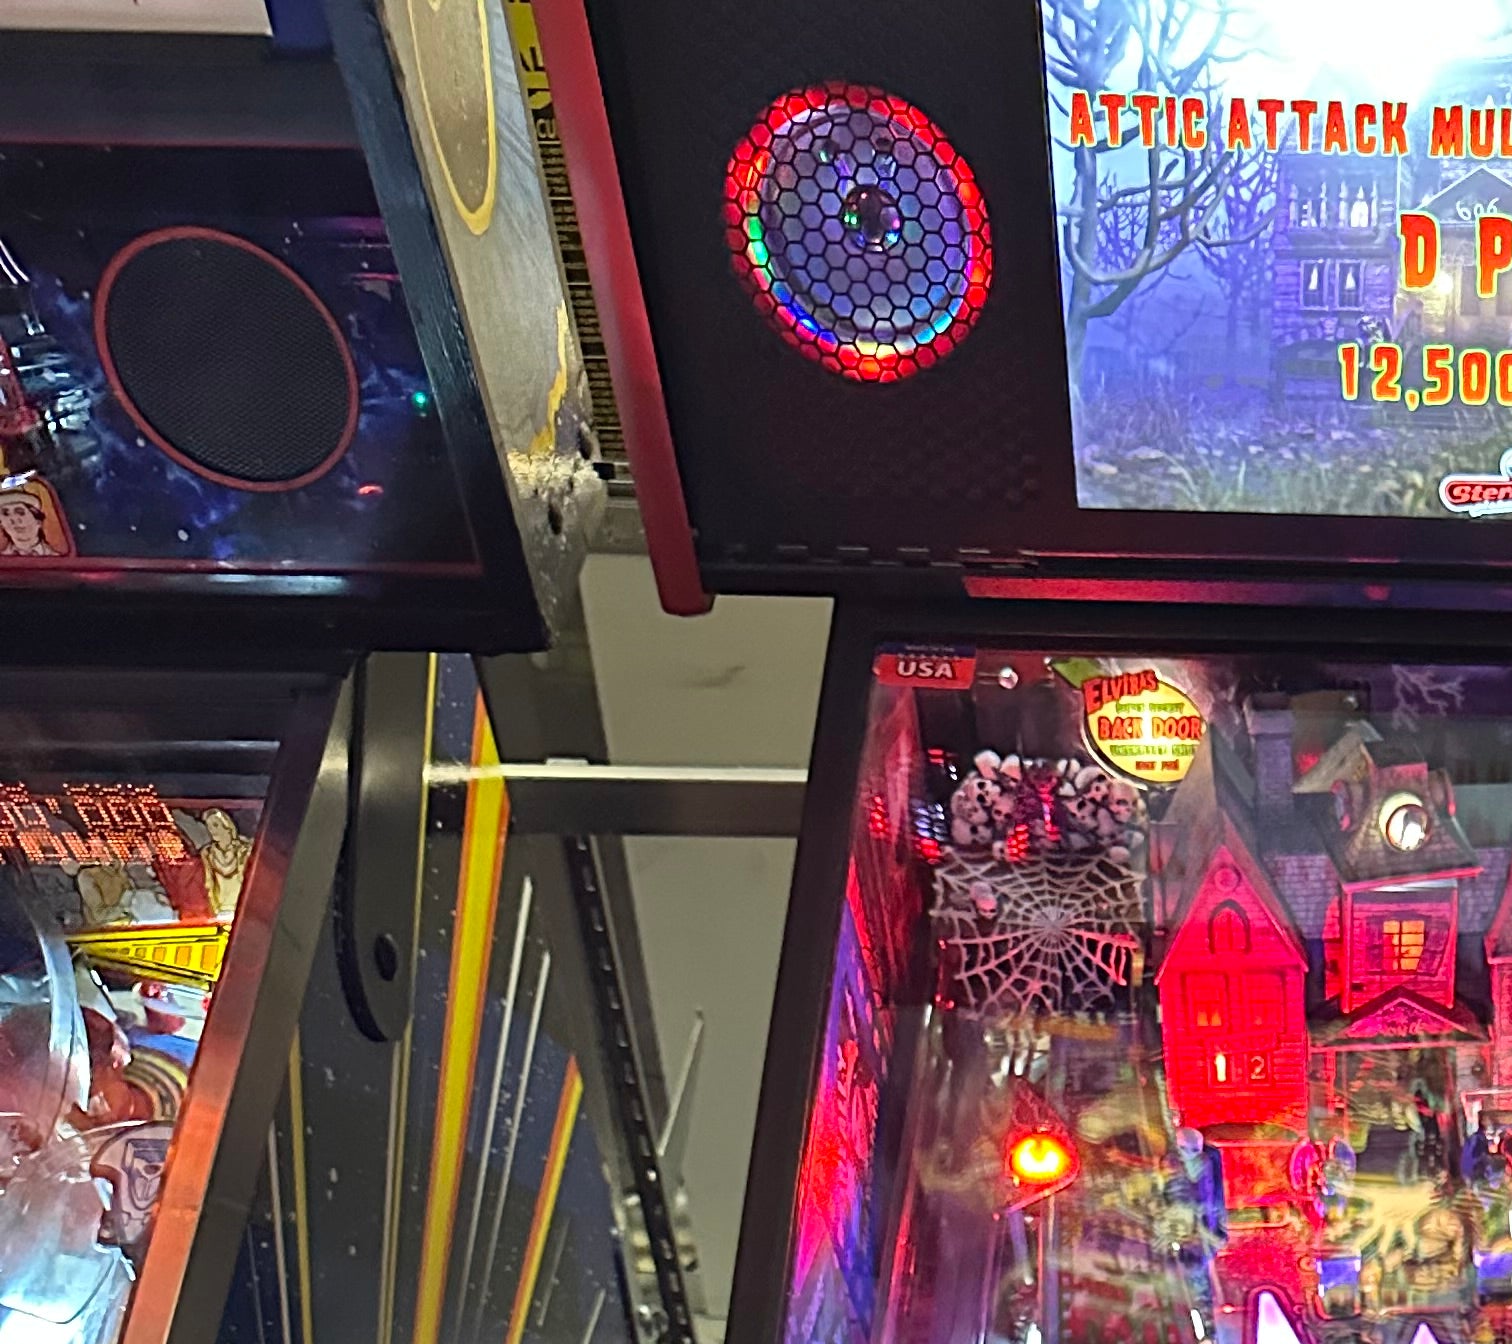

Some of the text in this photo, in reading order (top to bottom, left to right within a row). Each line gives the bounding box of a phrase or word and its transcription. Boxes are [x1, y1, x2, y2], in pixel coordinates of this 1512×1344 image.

[1070, 92, 1207, 152] ATTIC
[1227, 97, 1409, 158] ATTACK
[1400, 212, 1438, 291] D
[897, 660, 954, 680] USA
[1098, 715, 1201, 741] BACK DOOR
